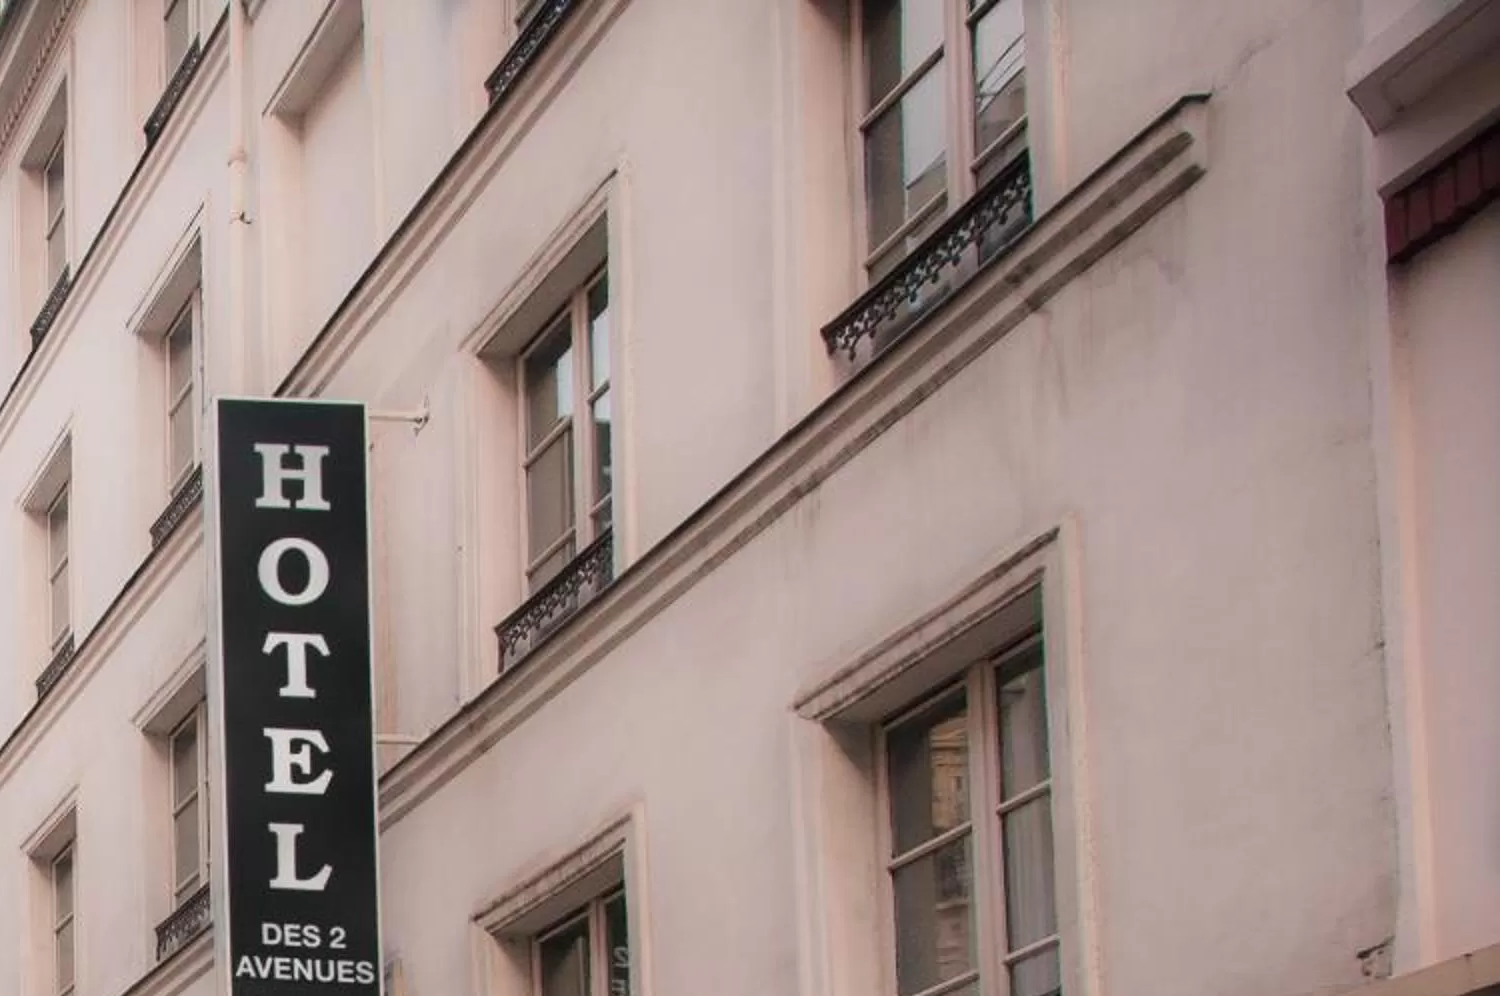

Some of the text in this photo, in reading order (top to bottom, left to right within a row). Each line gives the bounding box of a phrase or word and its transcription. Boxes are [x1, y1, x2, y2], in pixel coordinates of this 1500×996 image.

[253, 442, 334, 892] HOTEL
[260, 922, 347, 949] DES 2
[235, 956, 376, 985] AVENUES
